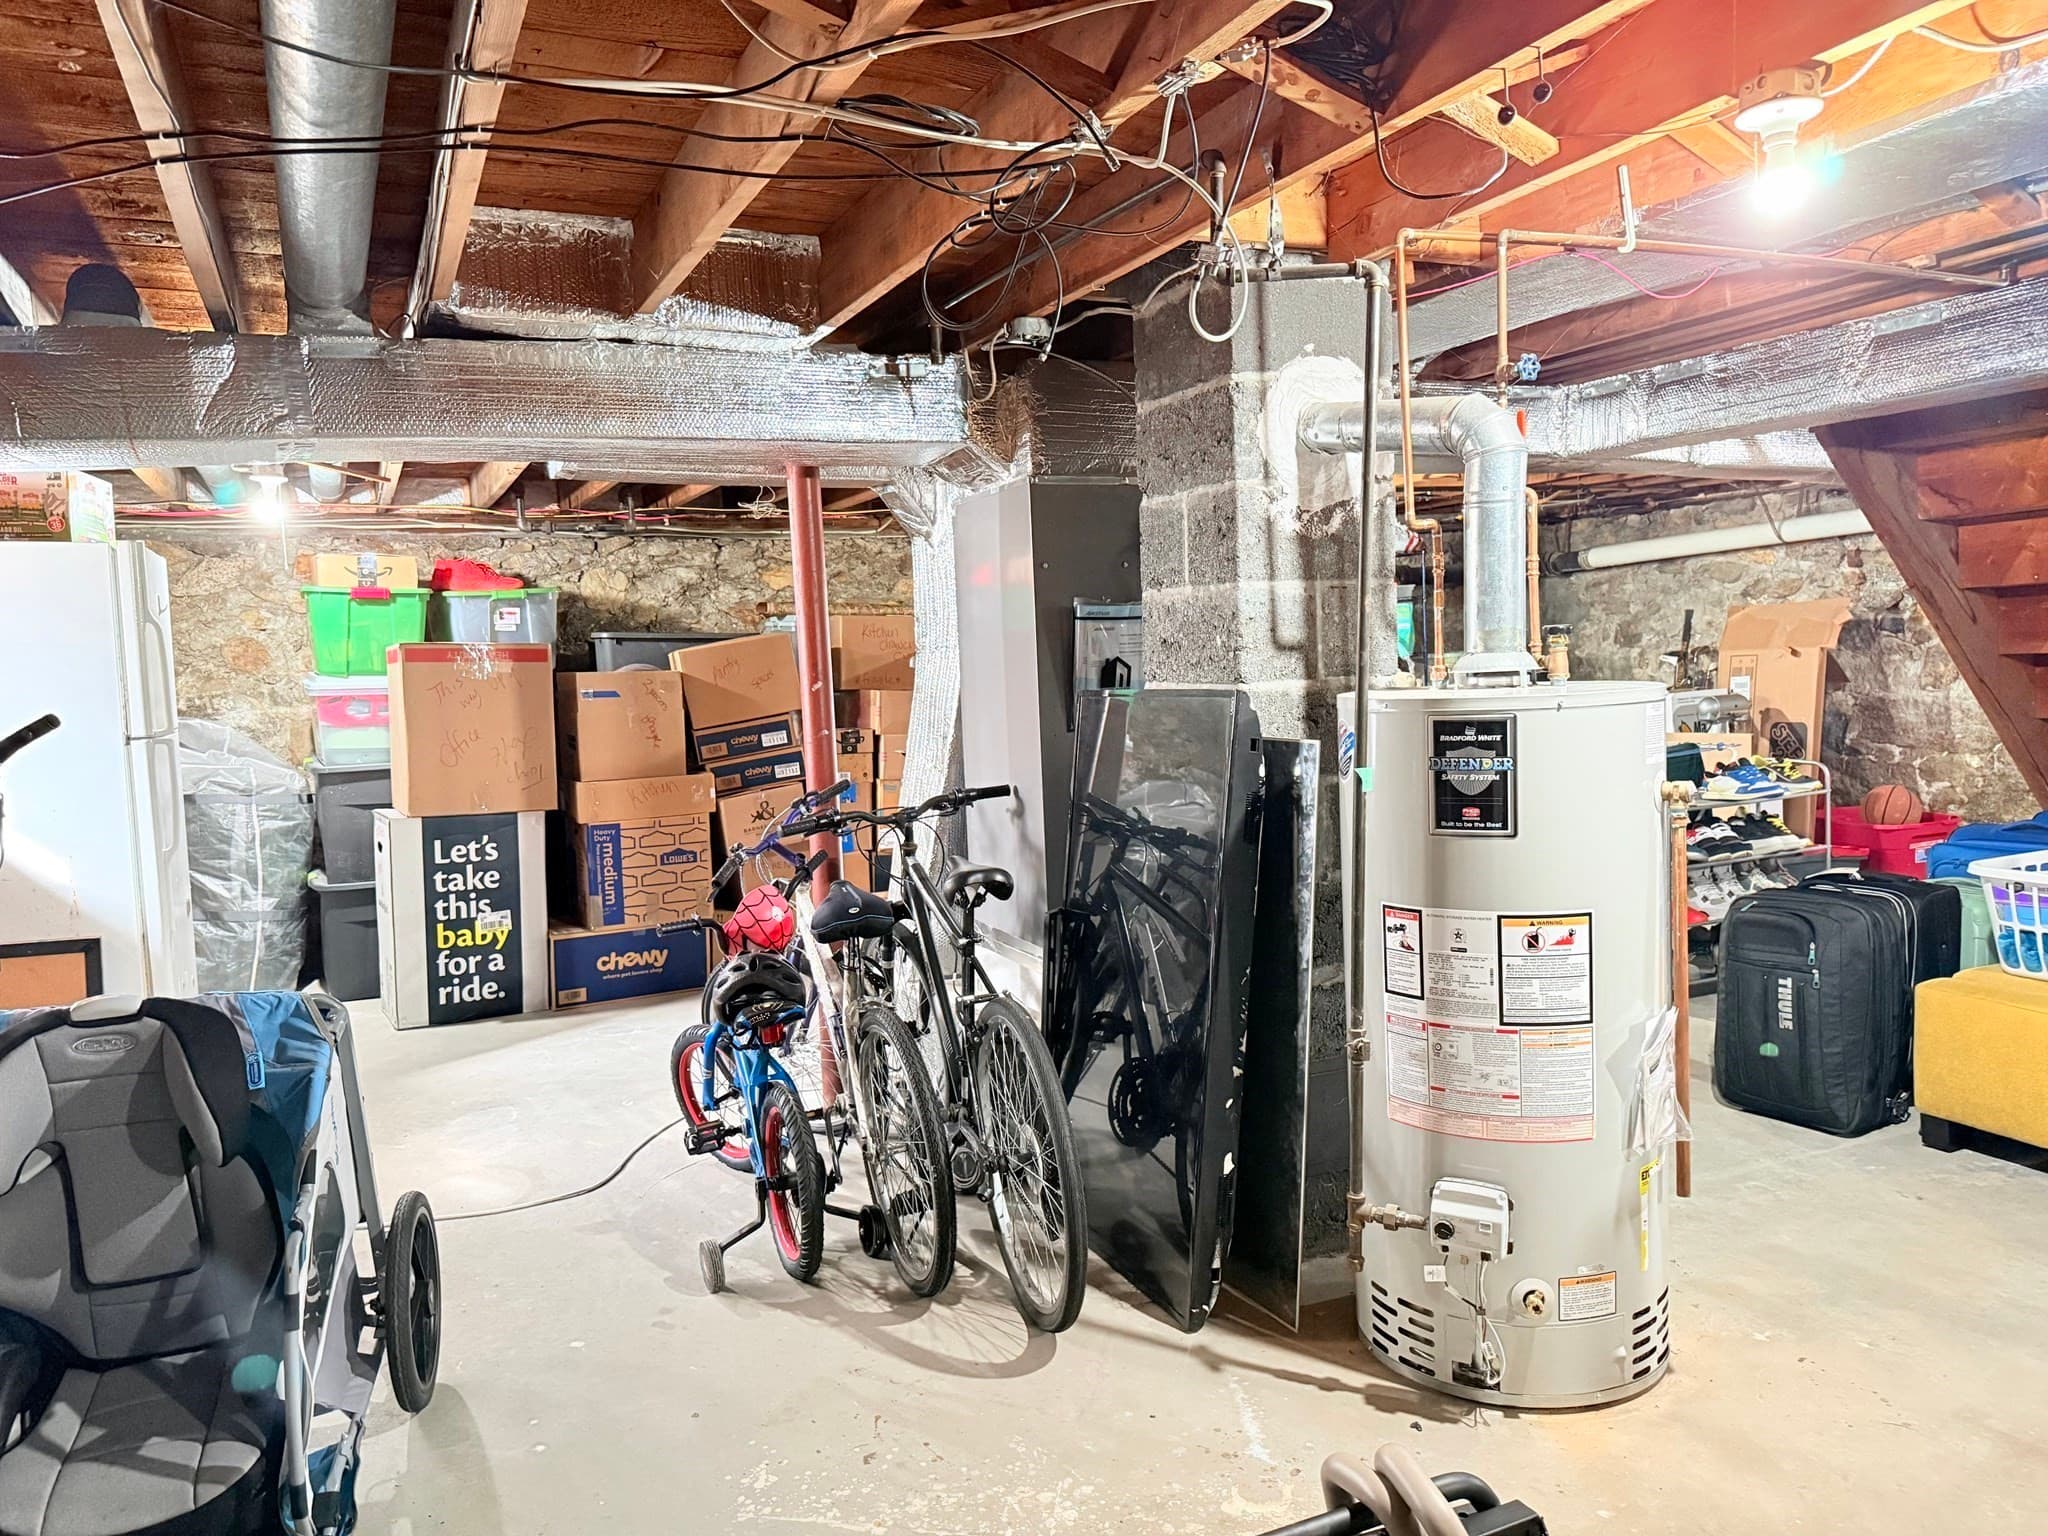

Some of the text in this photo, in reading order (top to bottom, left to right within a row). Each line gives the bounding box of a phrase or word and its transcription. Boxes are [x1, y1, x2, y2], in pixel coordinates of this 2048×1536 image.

[730, 734, 759, 745] chewy
[744, 765, 773, 777] chewy
[1430, 757, 1514, 771] DEFENDER
[1441, 773, 1500, 781] SAFETY SYSTEM
[433, 835, 500, 864] Let's
[663, 854, 695, 864] LOWE'S
[433, 864, 501, 893] take
[602, 842, 618, 905] medium
[433, 892, 493, 921] this
[436, 922, 510, 950] baby
[436, 950, 506, 977] for a
[596, 949, 669, 972] chewy
[438, 975, 507, 1005] ride.
[1777, 976, 1794, 1031] THULE
